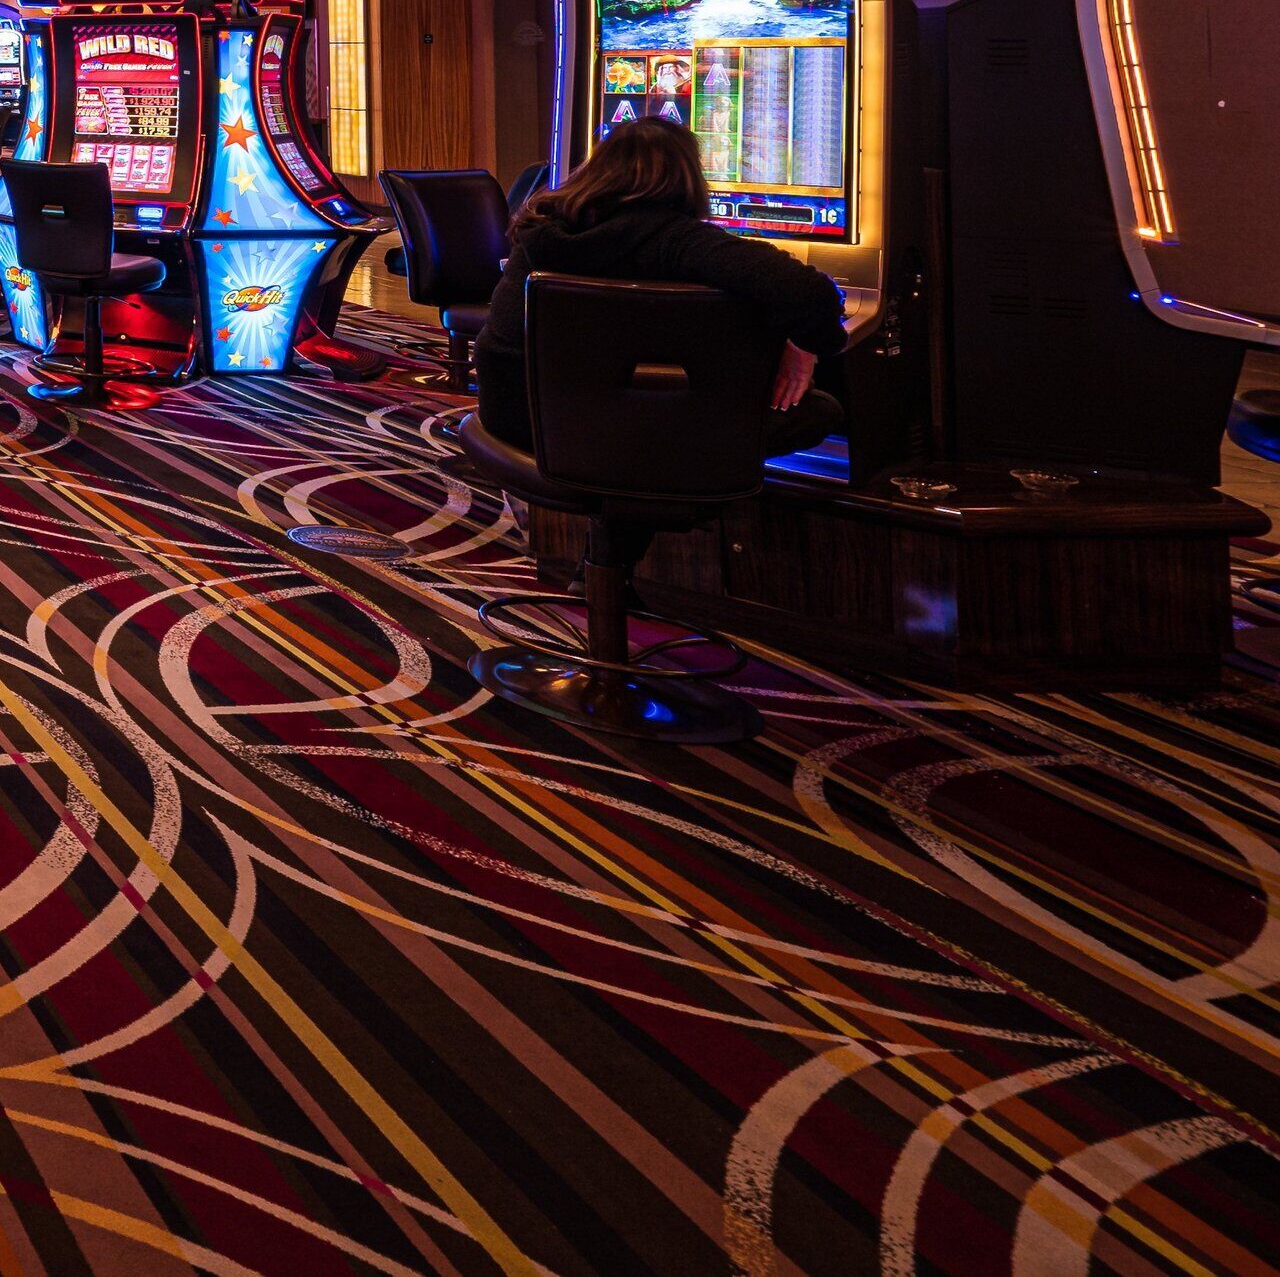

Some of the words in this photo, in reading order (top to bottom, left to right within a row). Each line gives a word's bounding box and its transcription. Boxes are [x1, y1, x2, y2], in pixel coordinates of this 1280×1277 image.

[78, 34, 132, 61] WILD
[133, 34, 176, 61] RED
[221, 290, 263, 306] Quick
[260, 289, 287, 305] Hit
